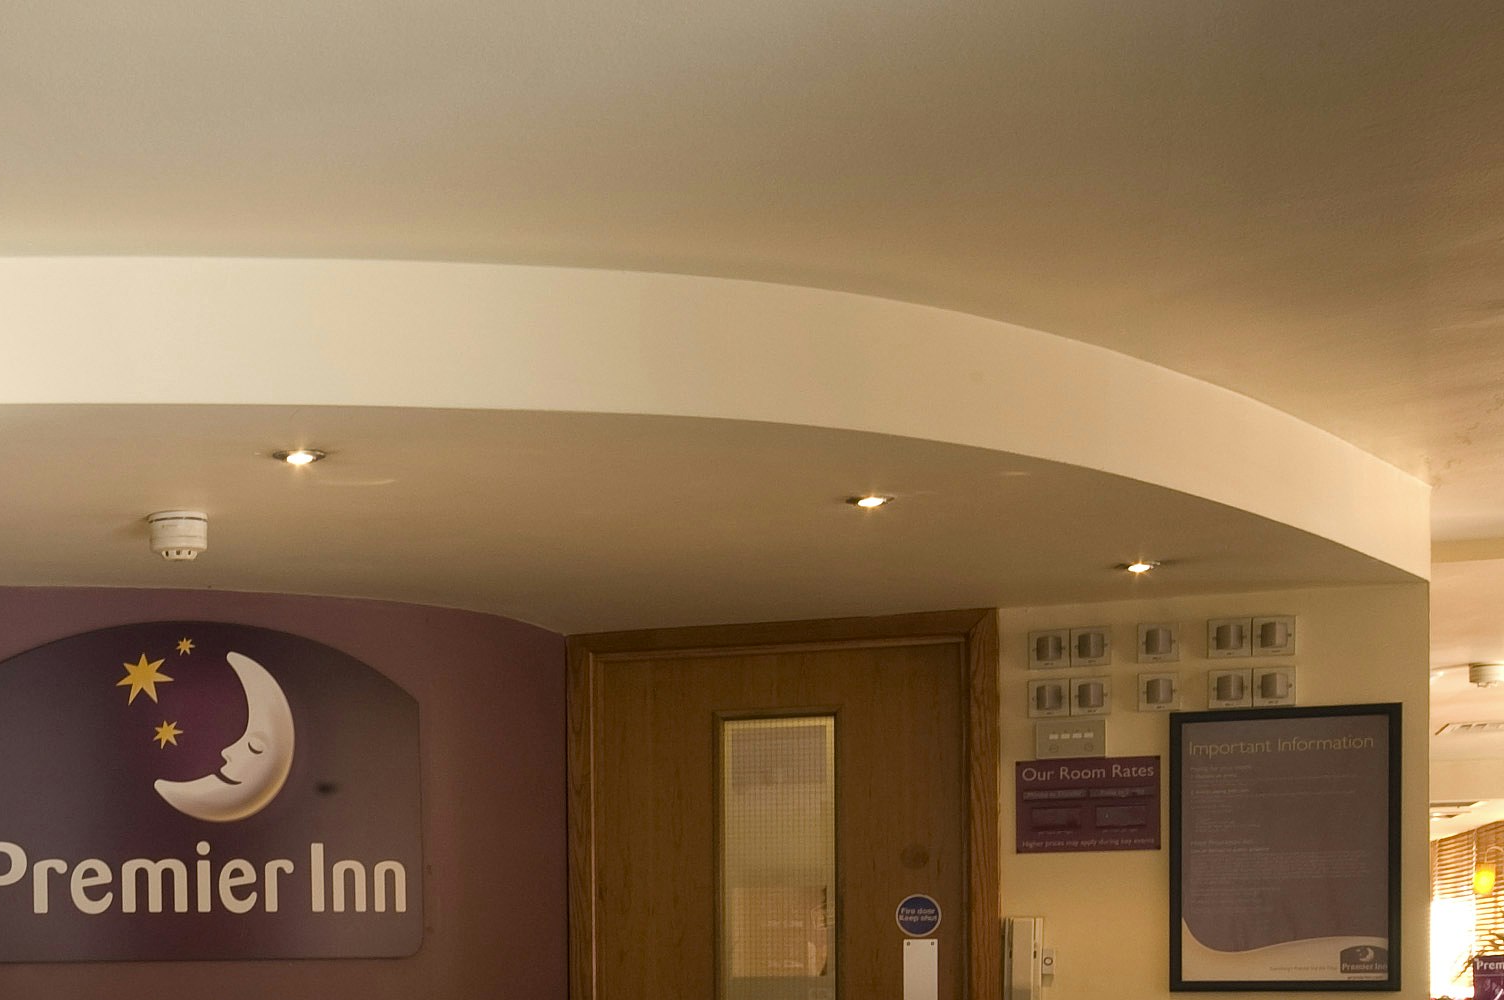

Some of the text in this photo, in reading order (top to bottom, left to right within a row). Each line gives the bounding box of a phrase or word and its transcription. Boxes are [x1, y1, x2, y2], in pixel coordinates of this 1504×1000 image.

[1188, 734, 1374, 759] Important Information
[1022, 764, 1155, 781] Our Room Rates
[311, 842, 407, 912] Inn
[899, 914, 919, 922] Keep
